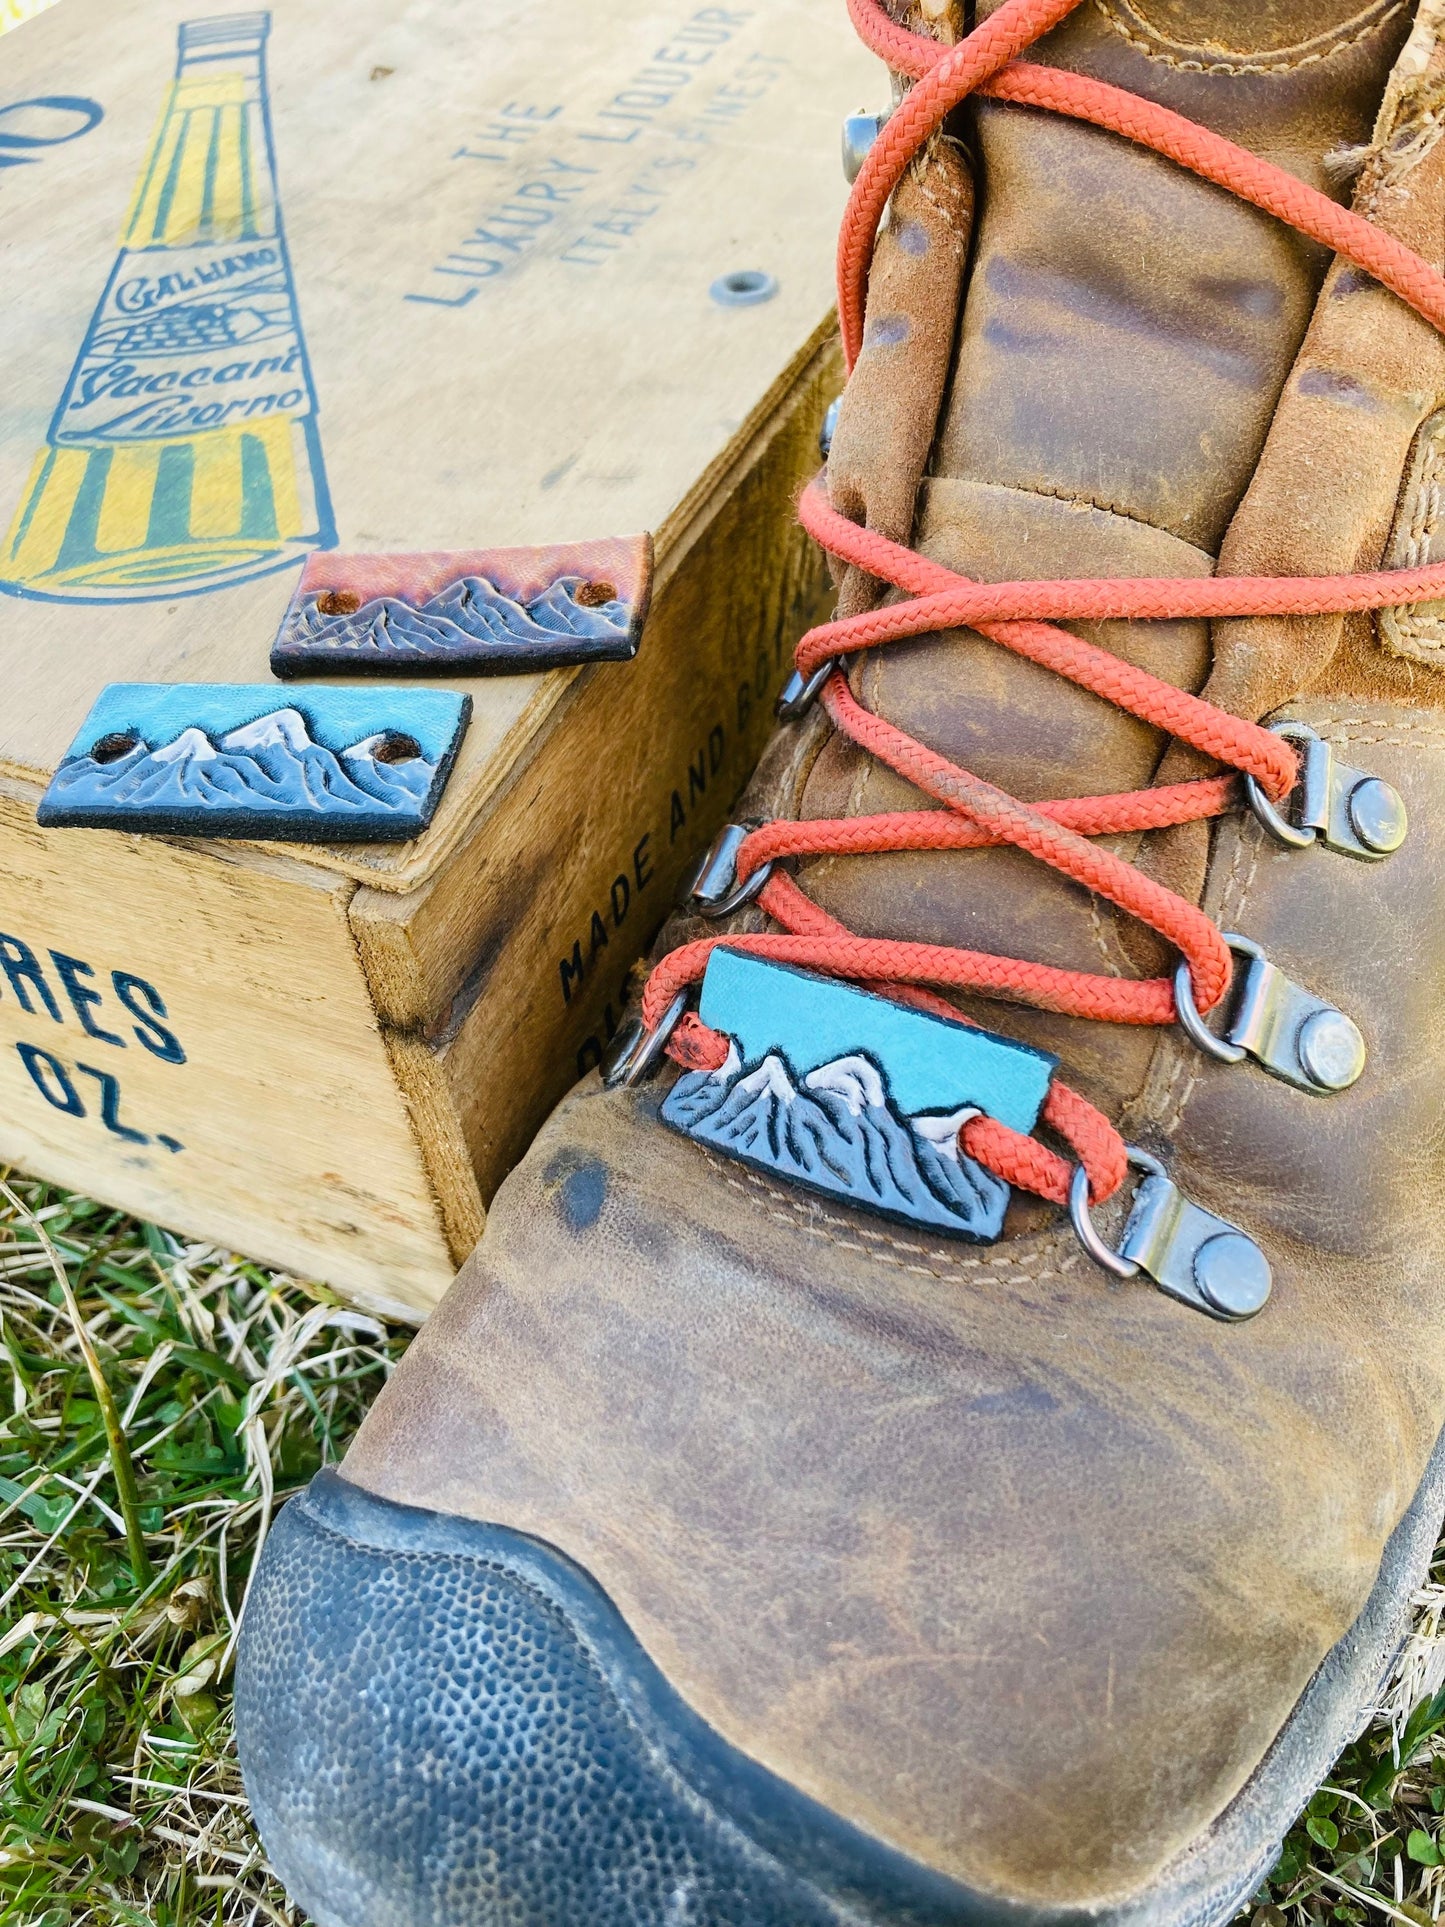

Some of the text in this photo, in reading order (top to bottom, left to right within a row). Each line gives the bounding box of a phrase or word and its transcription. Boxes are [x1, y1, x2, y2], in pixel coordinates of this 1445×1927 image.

[452, 102, 564, 161] THE
[676, 52, 793, 144] FINEST
[404, 7, 756, 307] LUXURY LIQUEUR
[116, 248, 277, 314] GALLIANO
[60, 388, 304, 441] Livorno
[69, 344, 301, 410] Vaccari
[560, 833, 655, 1002] MADE
[670, 725, 725, 844] AND
[0, 931, 187, 1065] RES
